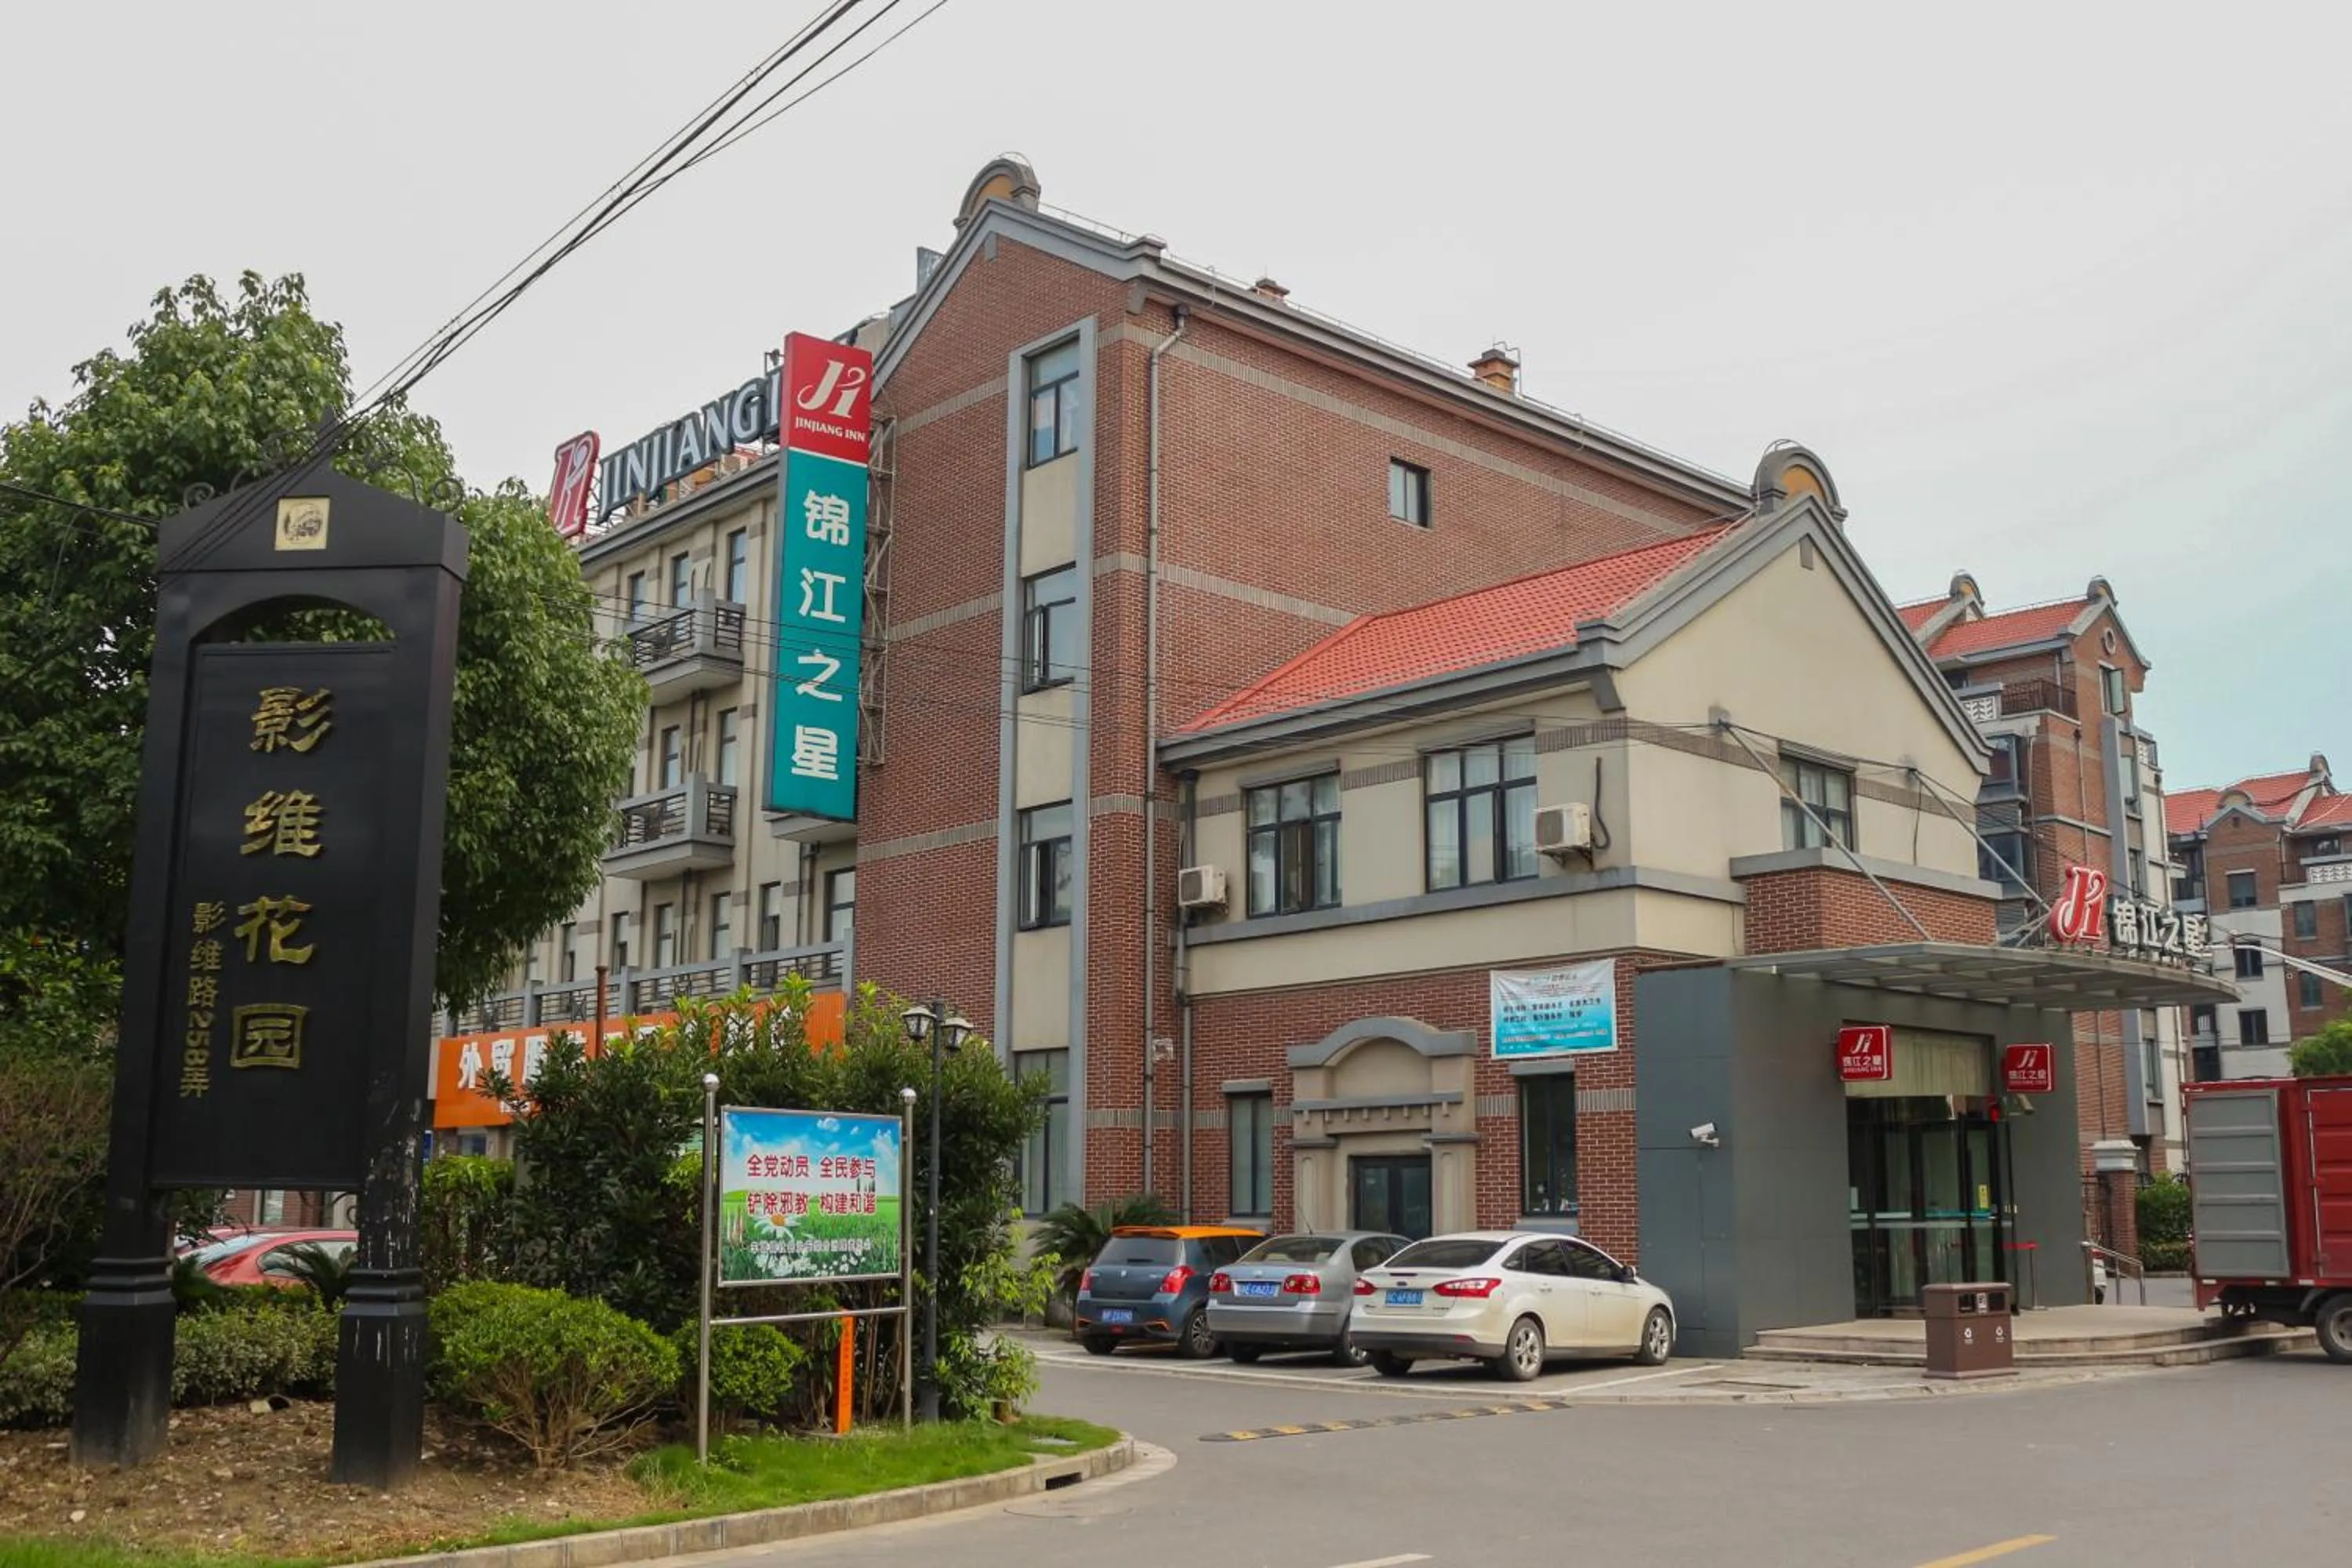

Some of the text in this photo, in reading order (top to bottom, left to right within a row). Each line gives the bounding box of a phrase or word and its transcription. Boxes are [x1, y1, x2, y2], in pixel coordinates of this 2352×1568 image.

[599, 380, 761, 521] JINJIANG
[795, 416, 866, 442] JINJIANG INN
[791, 489, 850, 781] 锦江之星
[230, 688, 336, 1069] 影维花园
[2114, 898, 2212, 957] 锦江之星
[180, 900, 226, 1098] 影维路258弄
[747, 1154, 876, 1179] 全党动员 全民参与
[747, 1192, 876, 1214] 铲除邪教 构建和谐
